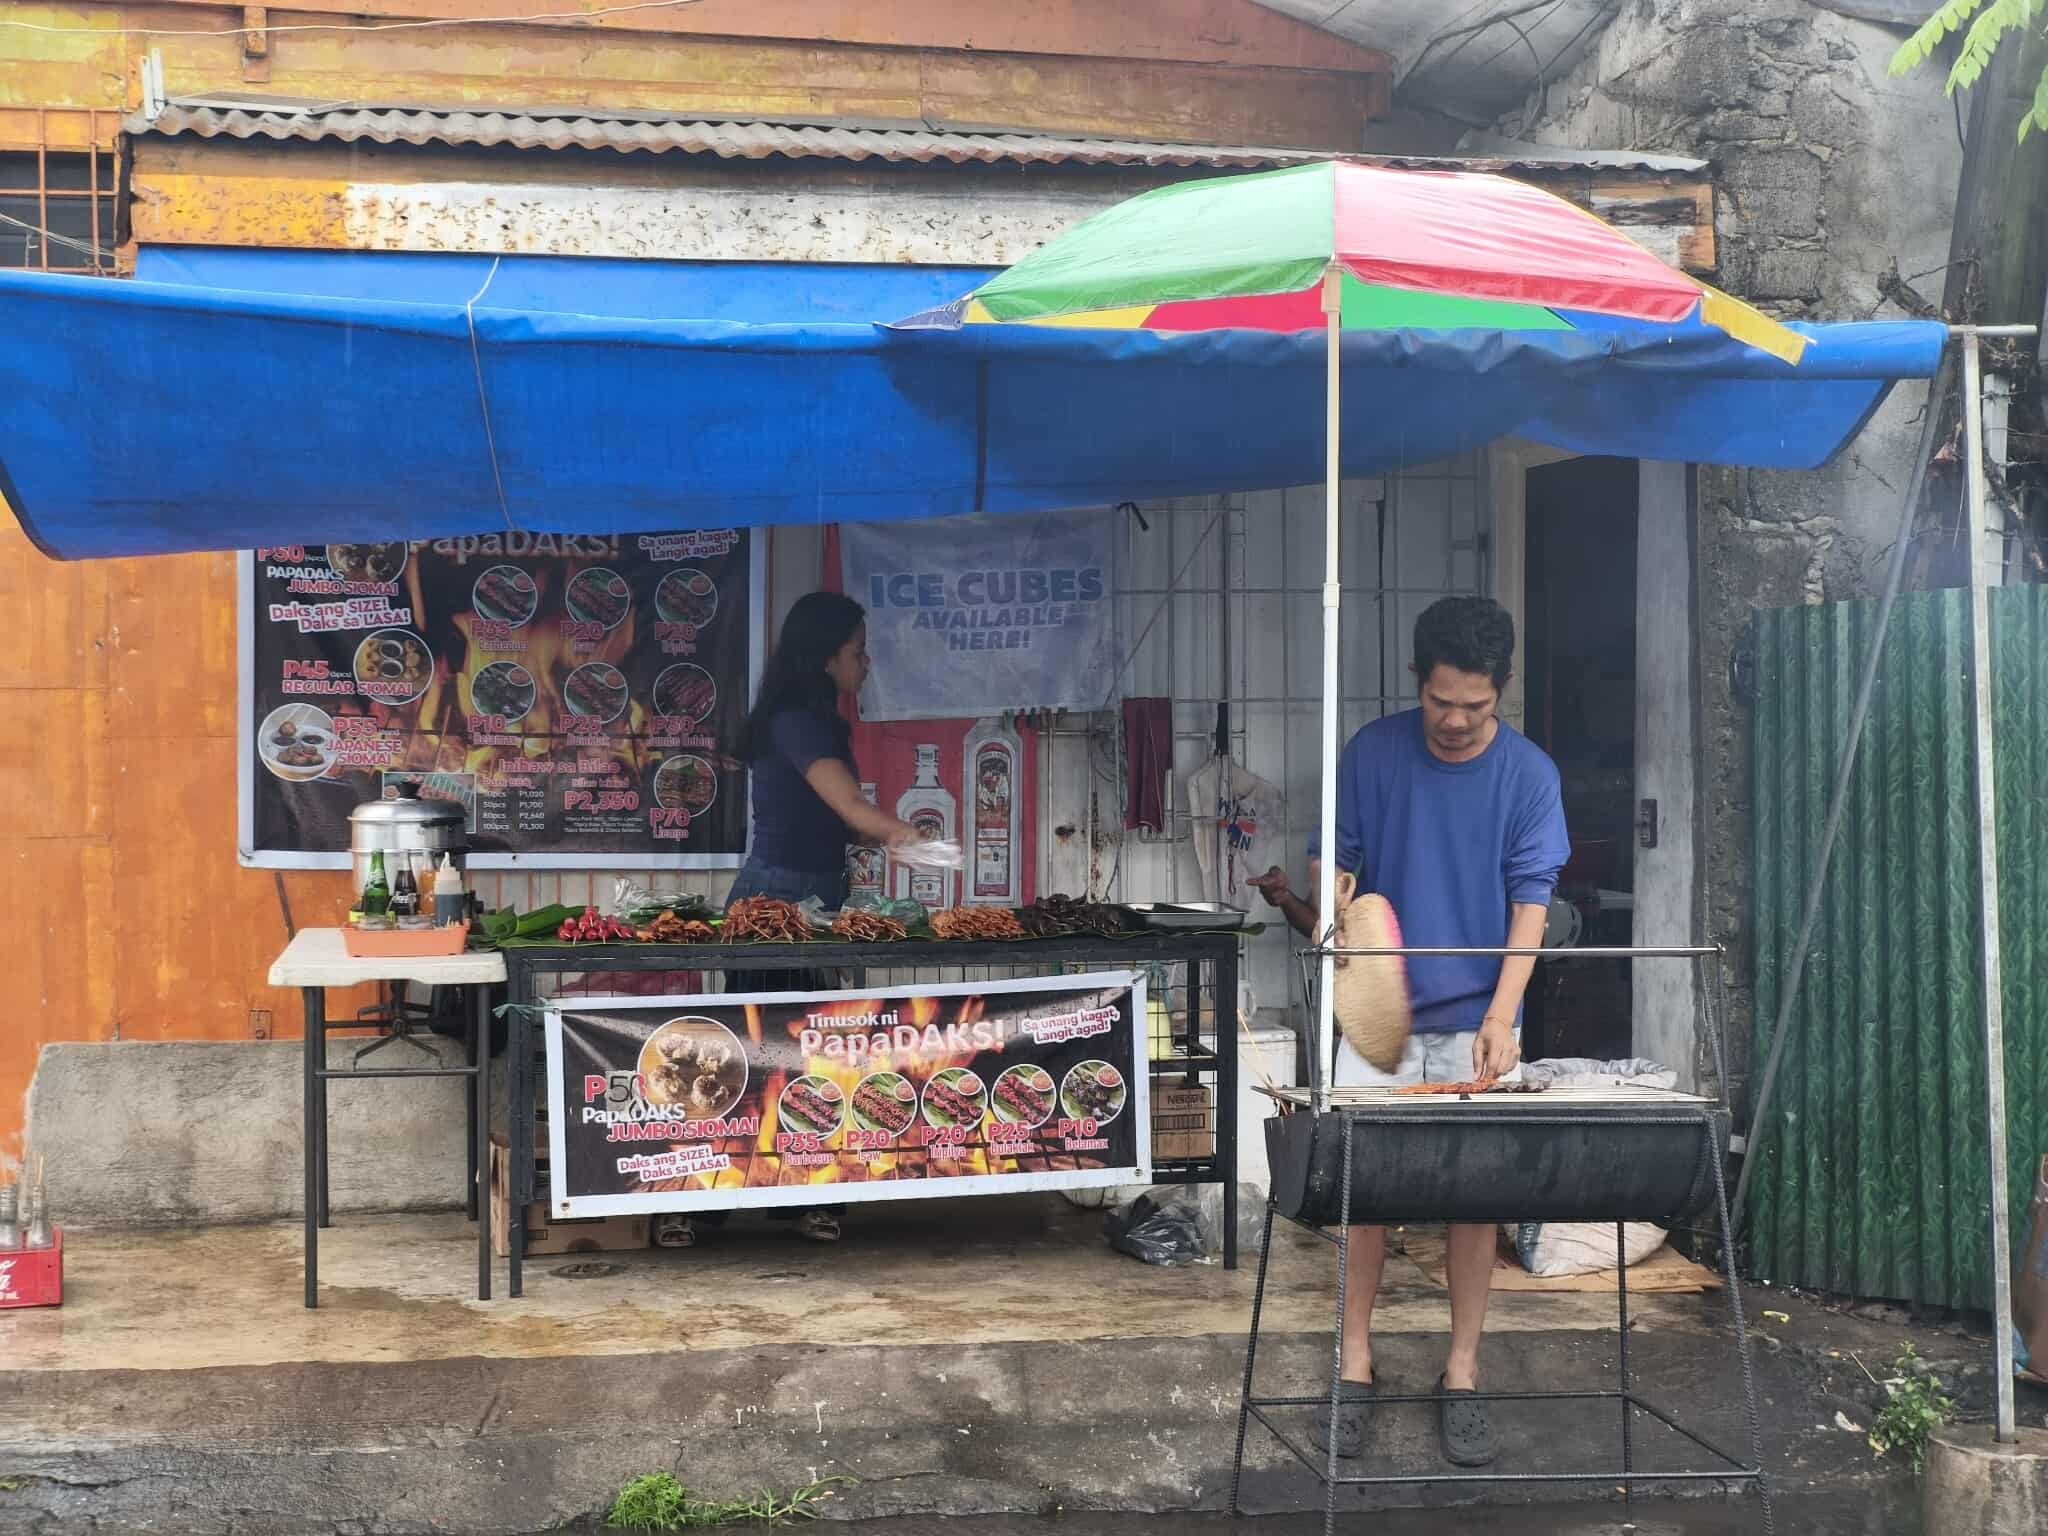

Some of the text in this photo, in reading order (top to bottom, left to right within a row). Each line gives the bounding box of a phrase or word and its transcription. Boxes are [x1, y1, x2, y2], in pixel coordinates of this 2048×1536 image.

[257, 544, 305, 563] P50
[267, 566, 345, 580] PAPADAKS
[287, 579, 399, 596] JUMBO SIOMAI
[871, 568, 1104, 608] ICE CUBES
[271, 599, 389, 621] Daks ang SIZE!
[300, 611, 410, 631] Daks sa LASA!
[912, 607, 1065, 630] AVAILABLE
[560, 621, 605, 640] P20
[949, 629, 1032, 651] HERE!
[283, 659, 330, 679] P45
[282, 680, 413, 697] REGULAR SIOMAI
[333, 716, 378, 737] P55
[467, 714, 507, 733] P10
[326, 739, 401, 753] JAPANESE
[337, 752, 392, 766] SIOMAI
[563, 790, 640, 814] P2,350
[650, 807, 692, 829] P70
[807, 1010, 898, 1028] Tinusok ni
[1022, 1007, 1119, 1033] Sa unang kagat,
[1035, 1019, 1110, 1042] Langit agad!
[799, 1018, 1005, 1067] PapaDAKS!
[607, 1116, 760, 1142] JUMBO SIOMAI
[846, 1127, 892, 1149] P20
[919, 1123, 968, 1146] P20
[987, 1120, 1031, 1142] P25
[1058, 1117, 1099, 1138] P10
[776, 1131, 821, 1153] P35
[618, 1148, 712, 1172] Daks ang SIZE!
[856, 1149, 882, 1162] Isaw
[641, 1157, 728, 1181] Daks sa LASA!
